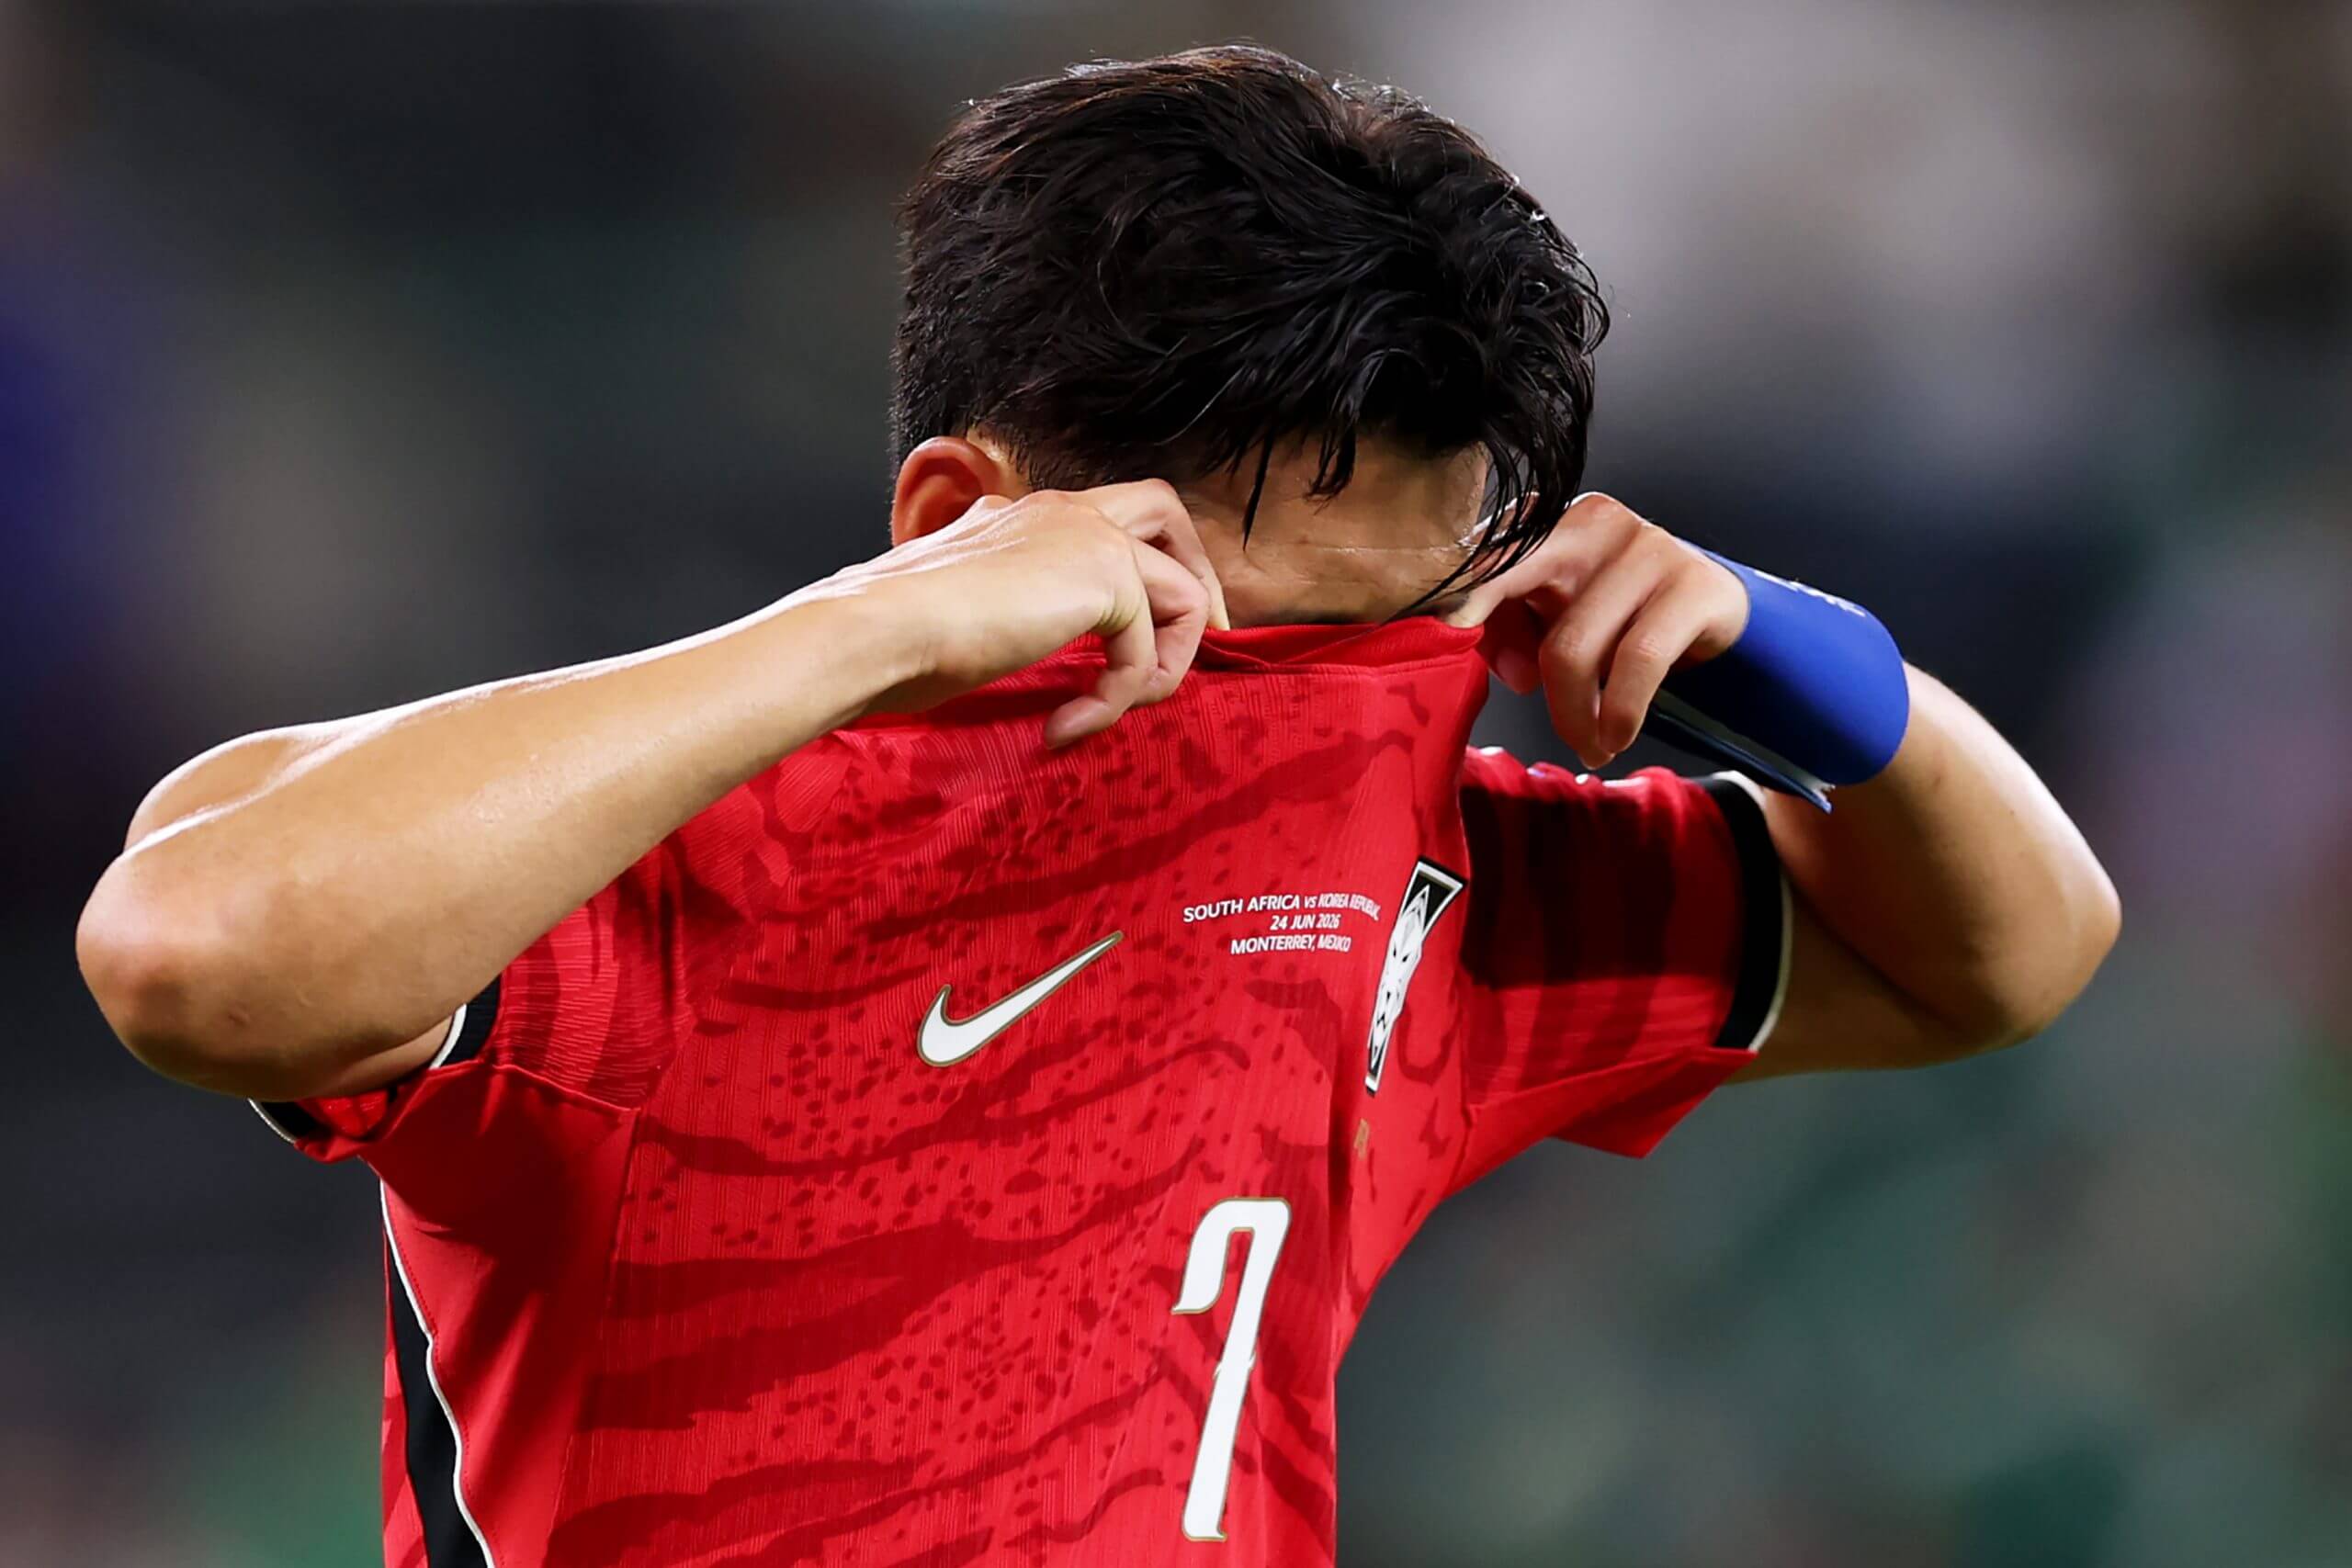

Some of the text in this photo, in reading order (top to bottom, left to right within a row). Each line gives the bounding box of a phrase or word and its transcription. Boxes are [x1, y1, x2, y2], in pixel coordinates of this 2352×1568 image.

[1183, 898, 1244, 923] SOUTH
[1247, 895, 1300, 912] AFRICA
[1317, 893, 1350, 908] KOREA
[1270, 913, 1341, 931] 24 JUN 2026
[1231, 934, 1317, 955] MONTERREY,
[1170, 1197, 1291, 1541] 7
